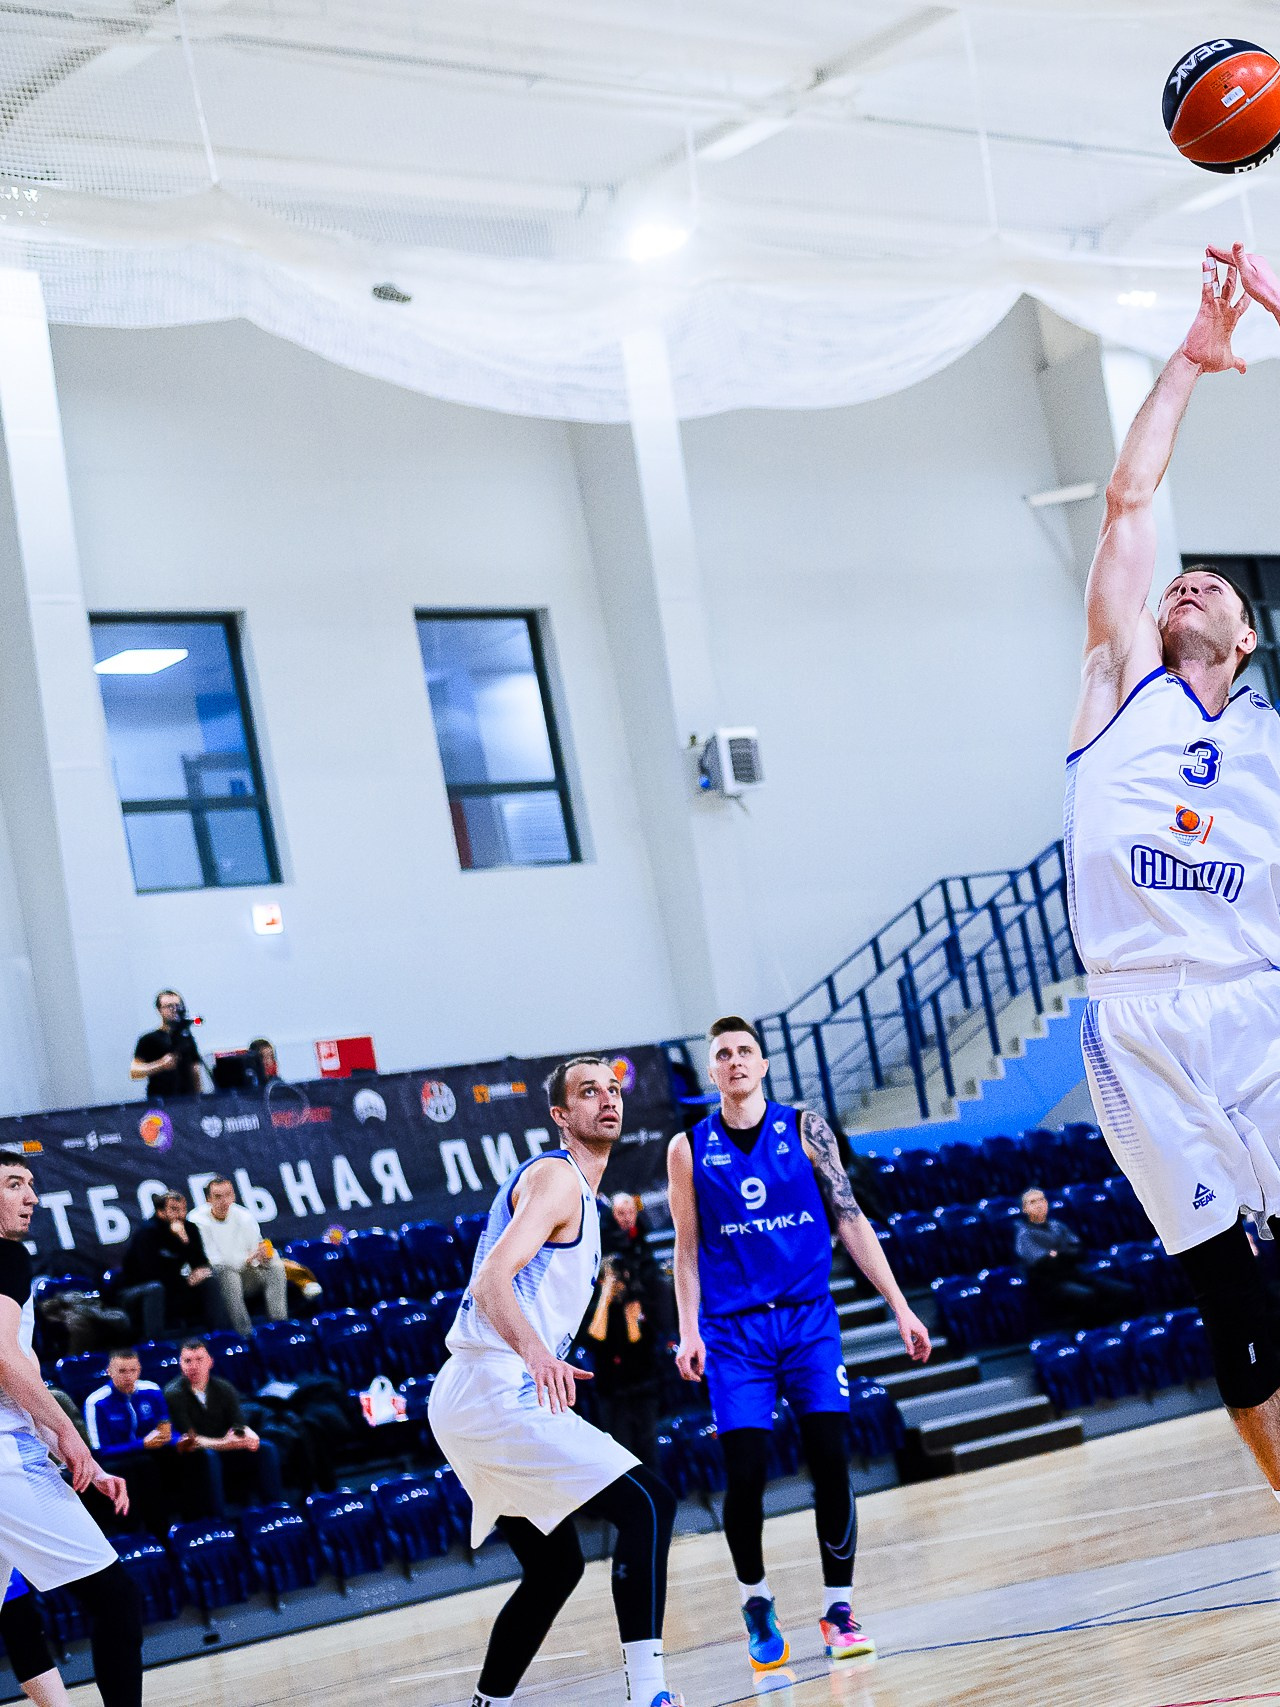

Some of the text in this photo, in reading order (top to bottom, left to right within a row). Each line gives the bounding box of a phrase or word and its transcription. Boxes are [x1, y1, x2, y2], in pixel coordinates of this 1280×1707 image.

[1169, 39, 1234, 94] PEAK
[1179, 737, 1224, 789] 3
[740, 1176, 768, 1211] 9
[1192, 1190, 1217, 1211] PEAK
